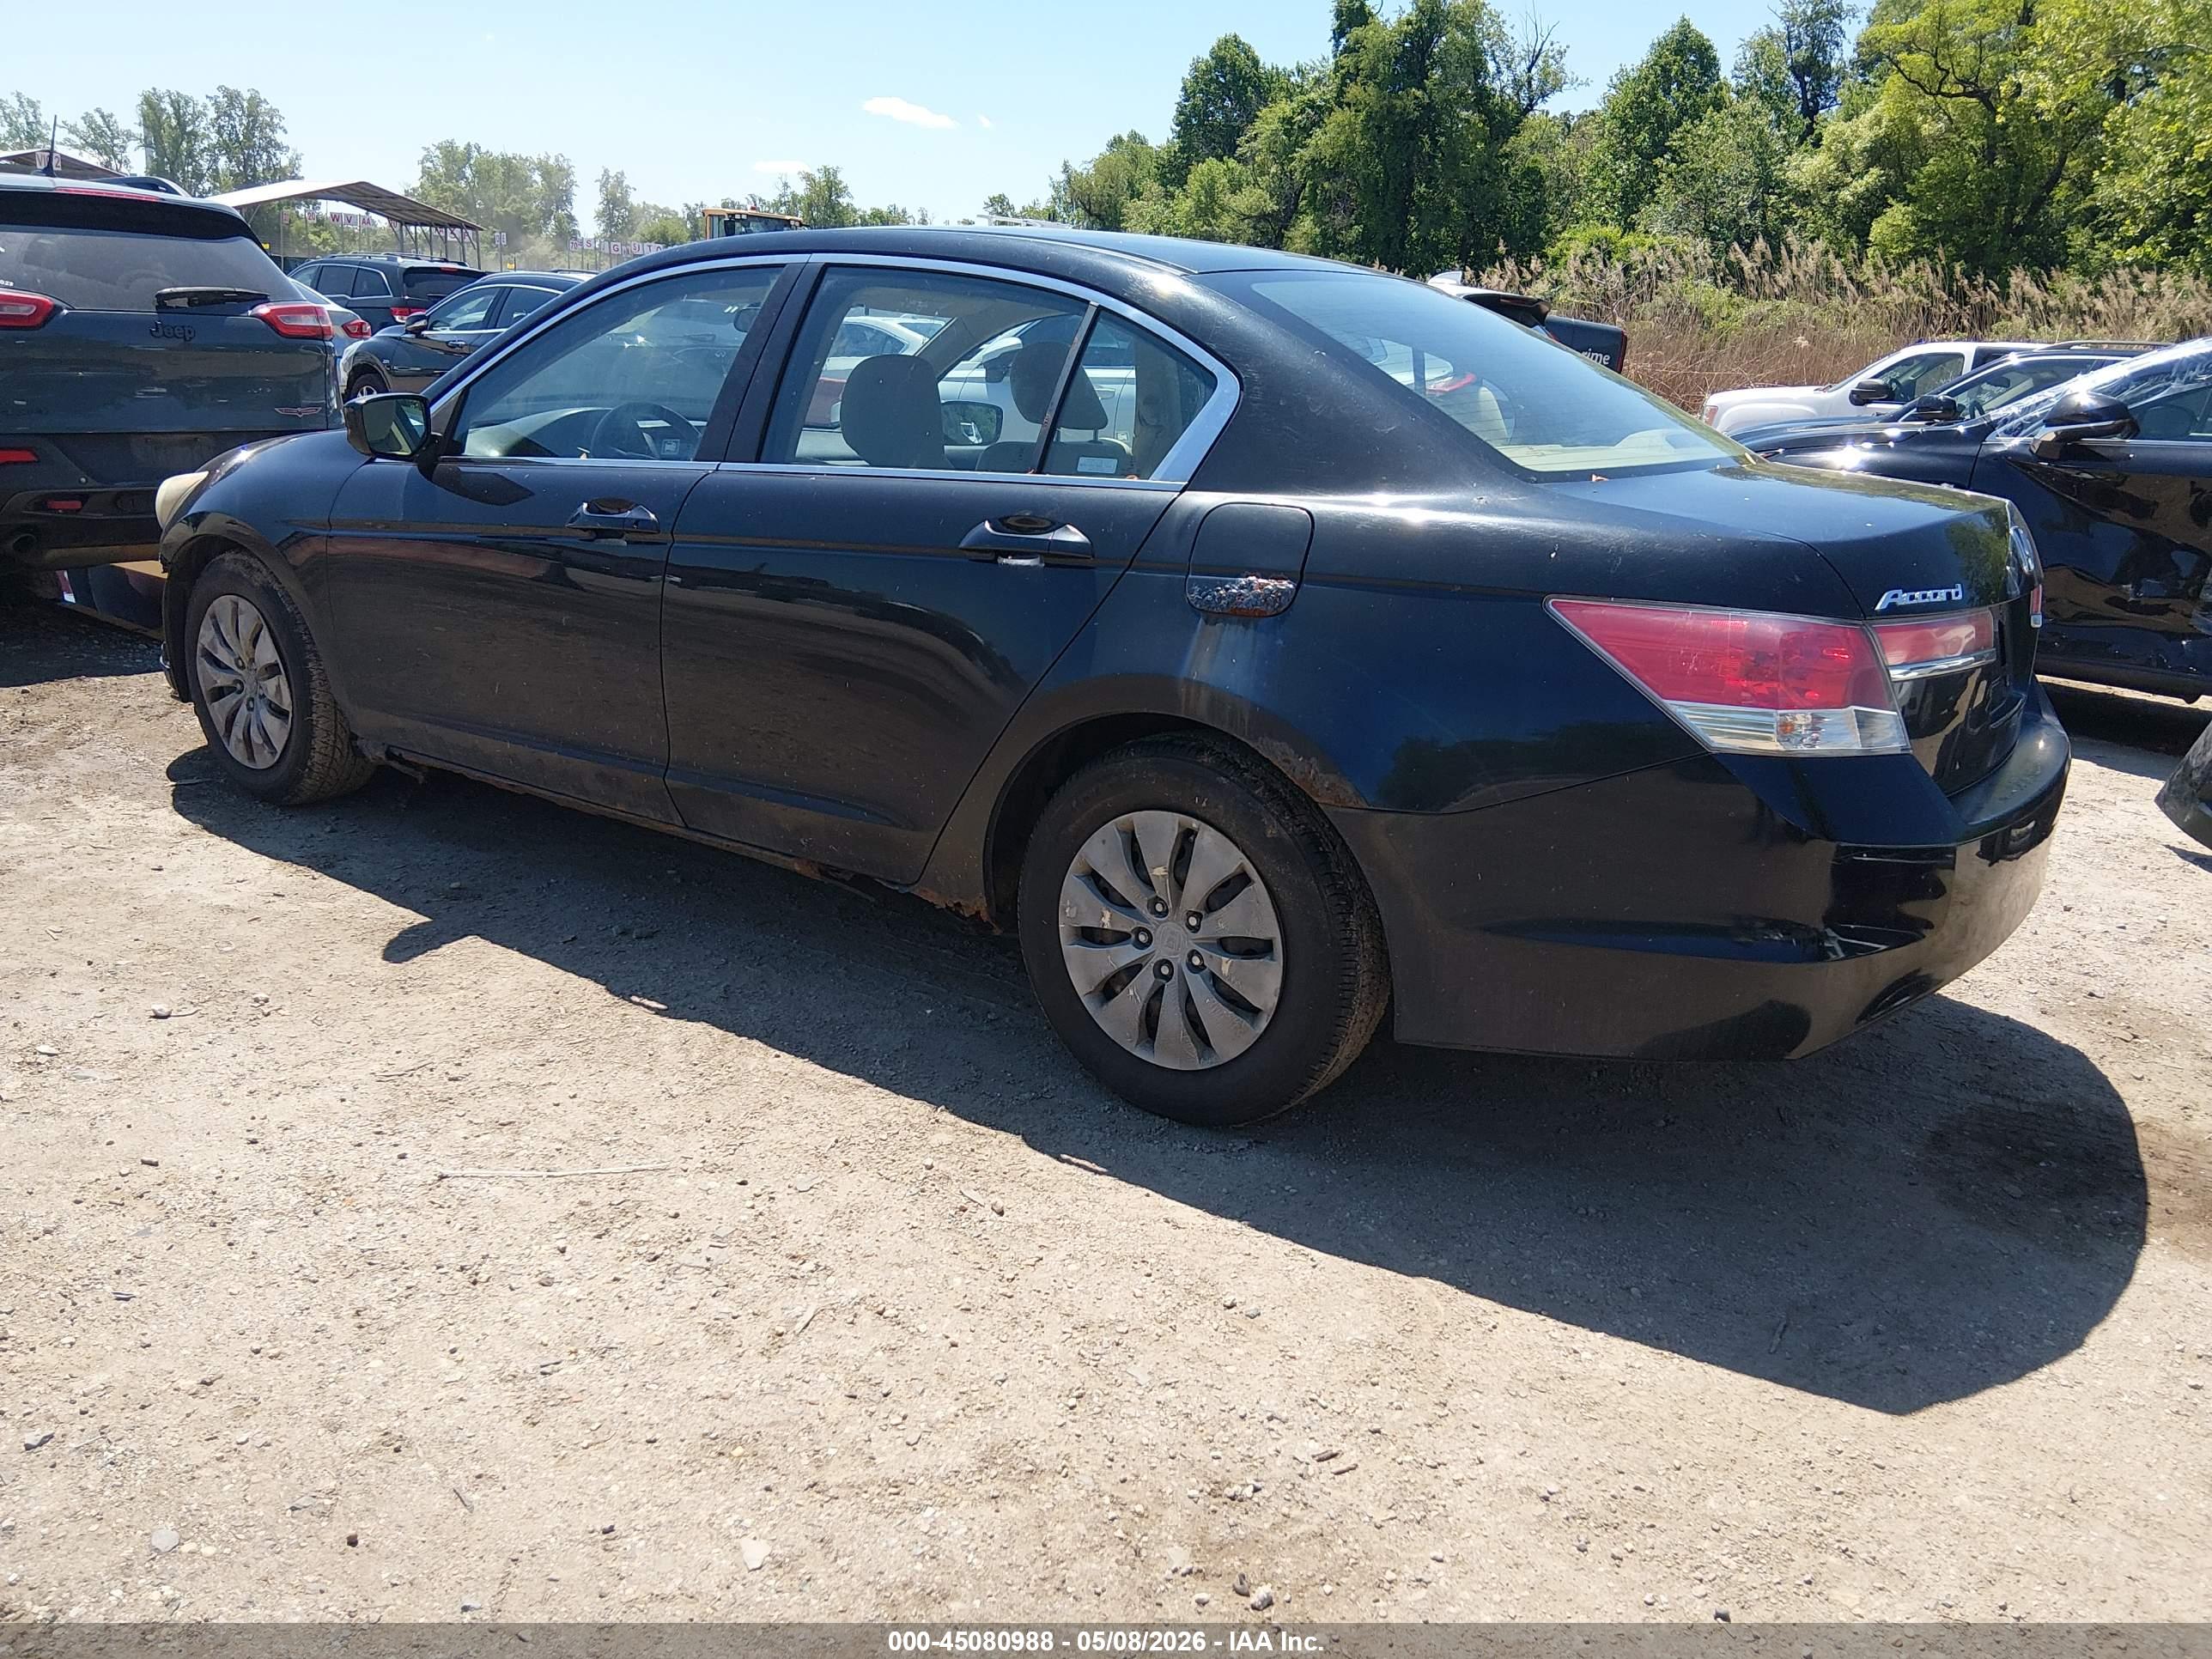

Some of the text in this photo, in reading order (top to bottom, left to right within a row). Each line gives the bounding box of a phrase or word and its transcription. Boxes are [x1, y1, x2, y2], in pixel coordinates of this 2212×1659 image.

[307, 211, 316, 222] 20
[331, 214, 340, 222] W
[586, 240, 592, 248] S
[612, 244, 619, 252] G
[149, 320, 196, 342] Jeep
[1874, 583, 1963, 611] Accord
